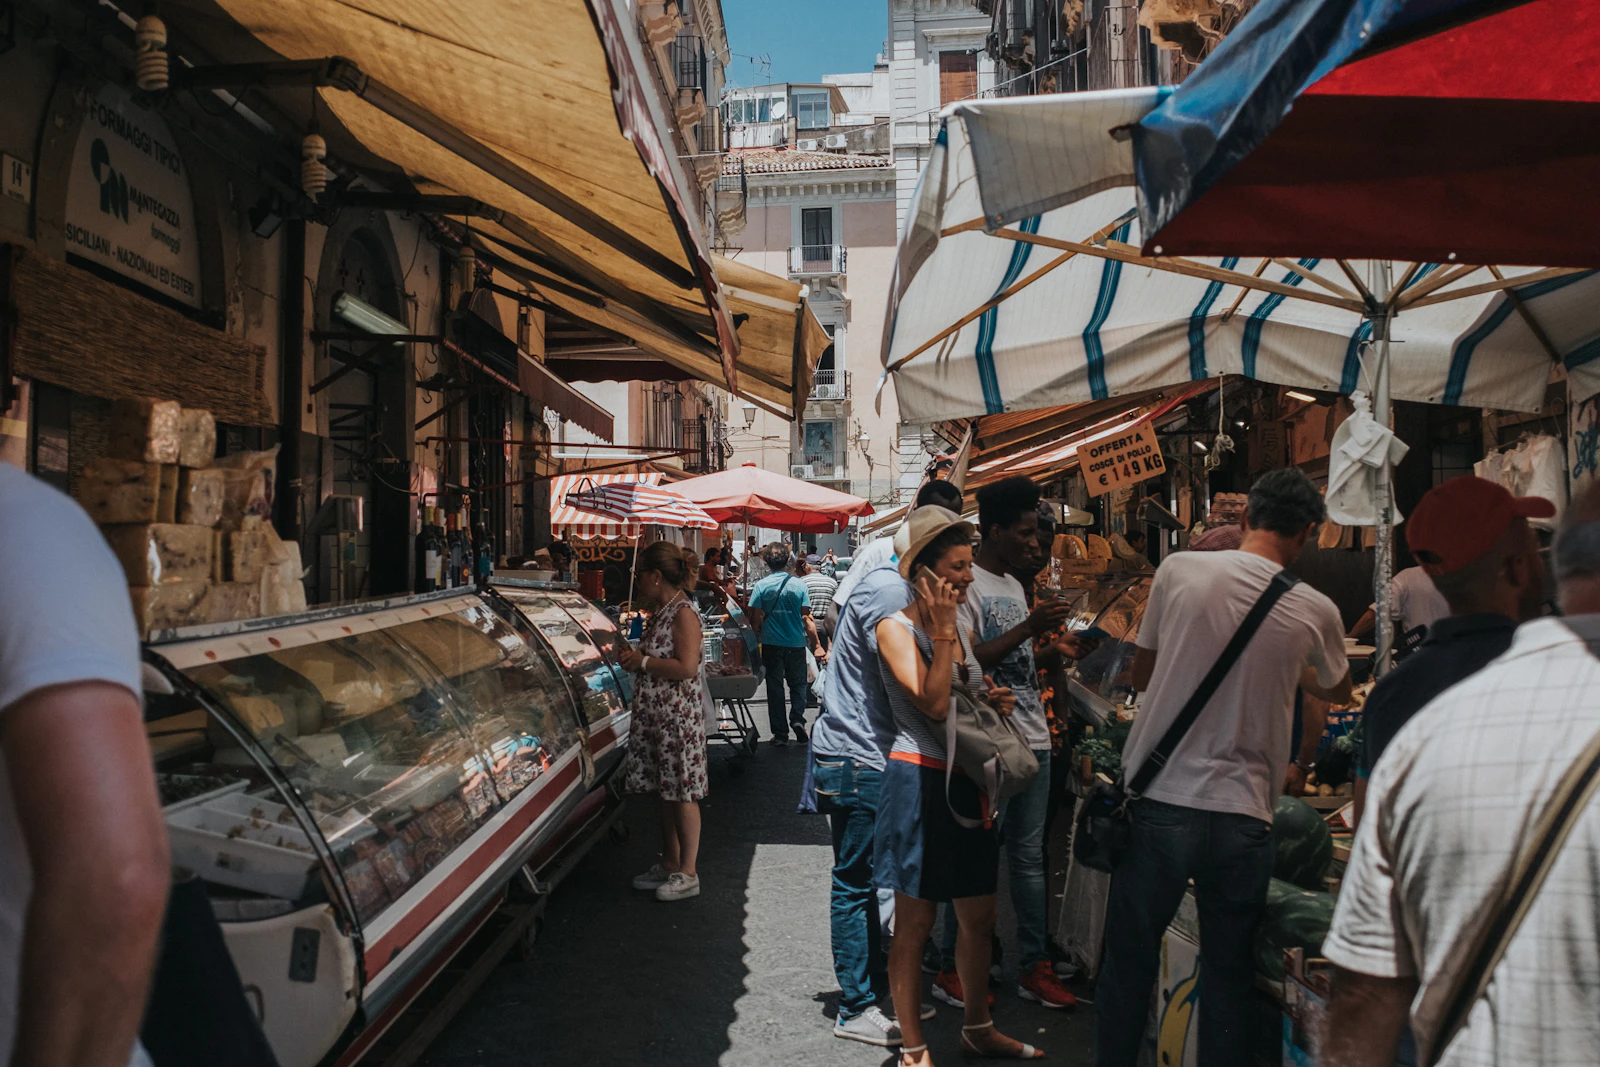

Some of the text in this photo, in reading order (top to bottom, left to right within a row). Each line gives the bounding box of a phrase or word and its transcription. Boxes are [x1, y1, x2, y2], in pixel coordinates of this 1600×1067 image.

[90, 102, 181, 176] FORMAGGI TIPICI
[129, 186, 181, 229] MANTEGAZZA
[65, 222, 111, 258] SICILIANI
[117, 246, 160, 281] NAZIONALI
[159, 267, 170, 286] ED
[171, 272, 195, 298] ESTERI
[1089, 458, 1115, 473] COSCE
[1127, 445, 1151, 459] POLLO
[1090, 433, 1143, 458] OFFERTA
[1143, 453, 1163, 471] KG
